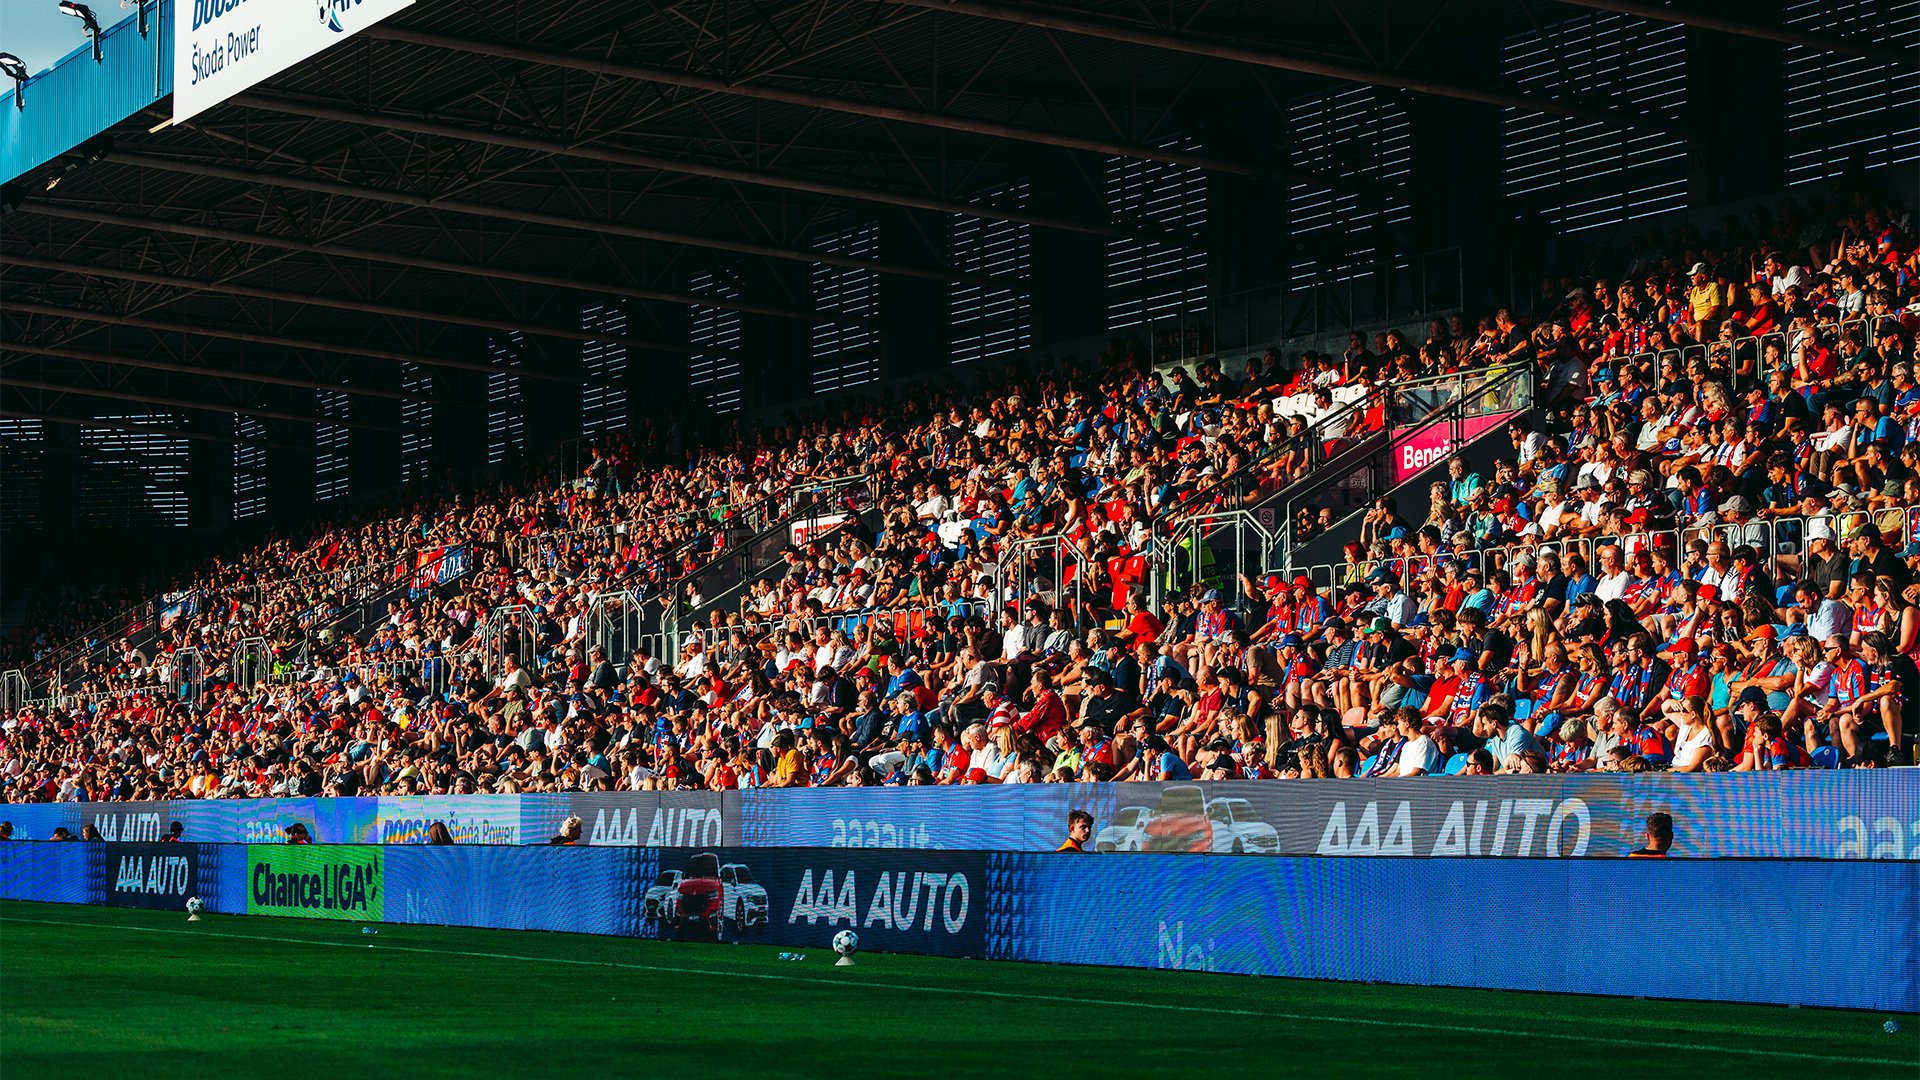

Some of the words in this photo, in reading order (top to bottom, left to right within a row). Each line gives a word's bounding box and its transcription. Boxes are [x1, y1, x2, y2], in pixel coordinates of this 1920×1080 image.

[192, 38, 224, 86] Škoda
[227, 24, 262, 66] Power
[121, 812, 161, 842] AUTO
[482, 819, 516, 844] Power
[589, 808, 638, 847] AAA
[645, 807, 723, 847] AUTO
[1316, 801, 1413, 856] AAA
[1430, 797, 1592, 857] AUTO
[115, 855, 144, 893] AAA
[147, 856, 189, 895] AUTO
[788, 869, 857, 927] AAA
[864, 871, 969, 933] AUTO
